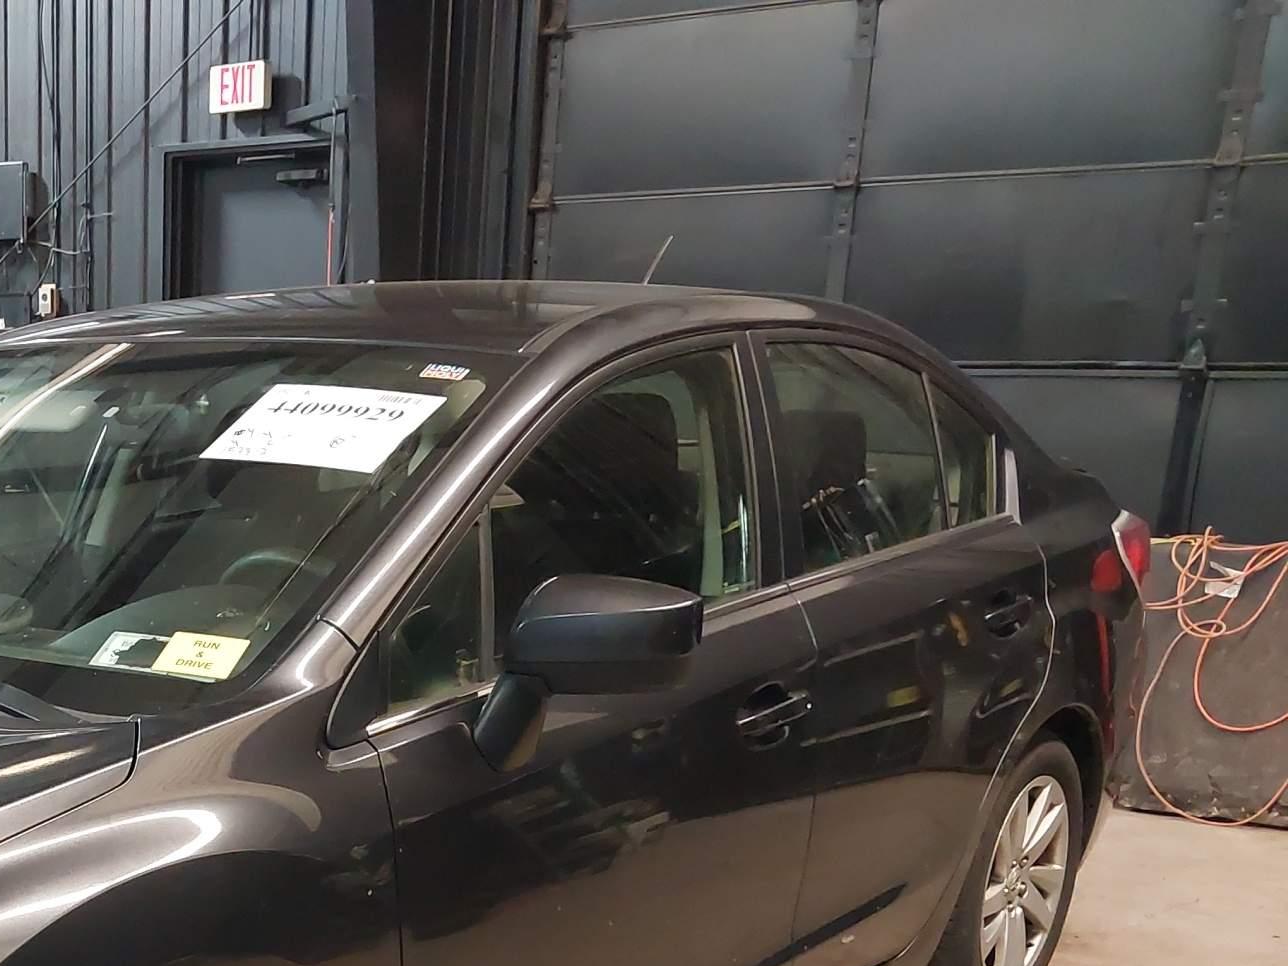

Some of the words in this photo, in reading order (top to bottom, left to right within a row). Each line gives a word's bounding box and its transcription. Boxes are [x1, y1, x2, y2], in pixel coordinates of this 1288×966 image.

[220, 64, 255, 105] EXIT
[430, 364, 465, 373] LIQUI
[267, 400, 405, 422] 44099929
[193, 640, 220, 650] RUN
[176, 658, 214, 670] DRIVE
